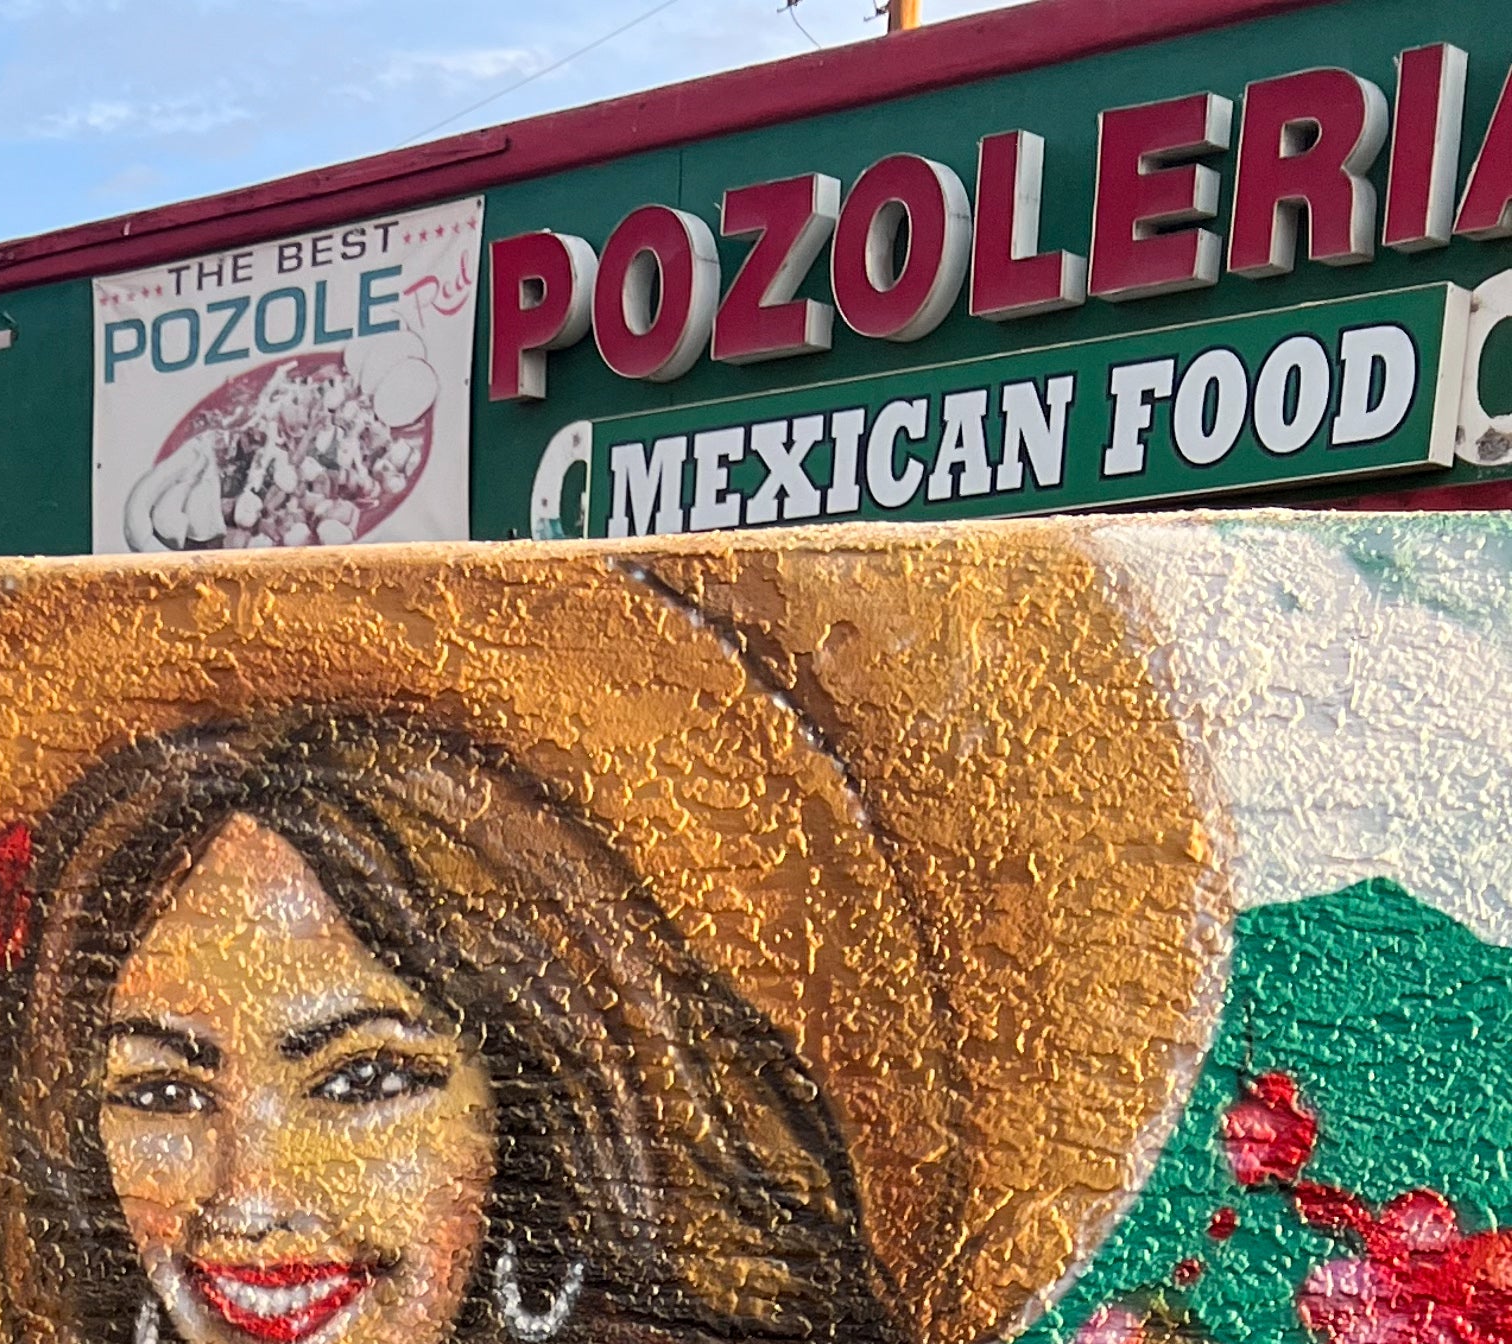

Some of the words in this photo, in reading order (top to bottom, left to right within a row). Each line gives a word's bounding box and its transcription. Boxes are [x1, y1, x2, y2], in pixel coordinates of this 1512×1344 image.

[167, 252, 254, 296] THE
[277, 220, 400, 275] BEST
[103, 264, 404, 384] POZOLE
[607, 375, 1074, 537] MEXICAN
[1101, 322, 1420, 475] FOOD
